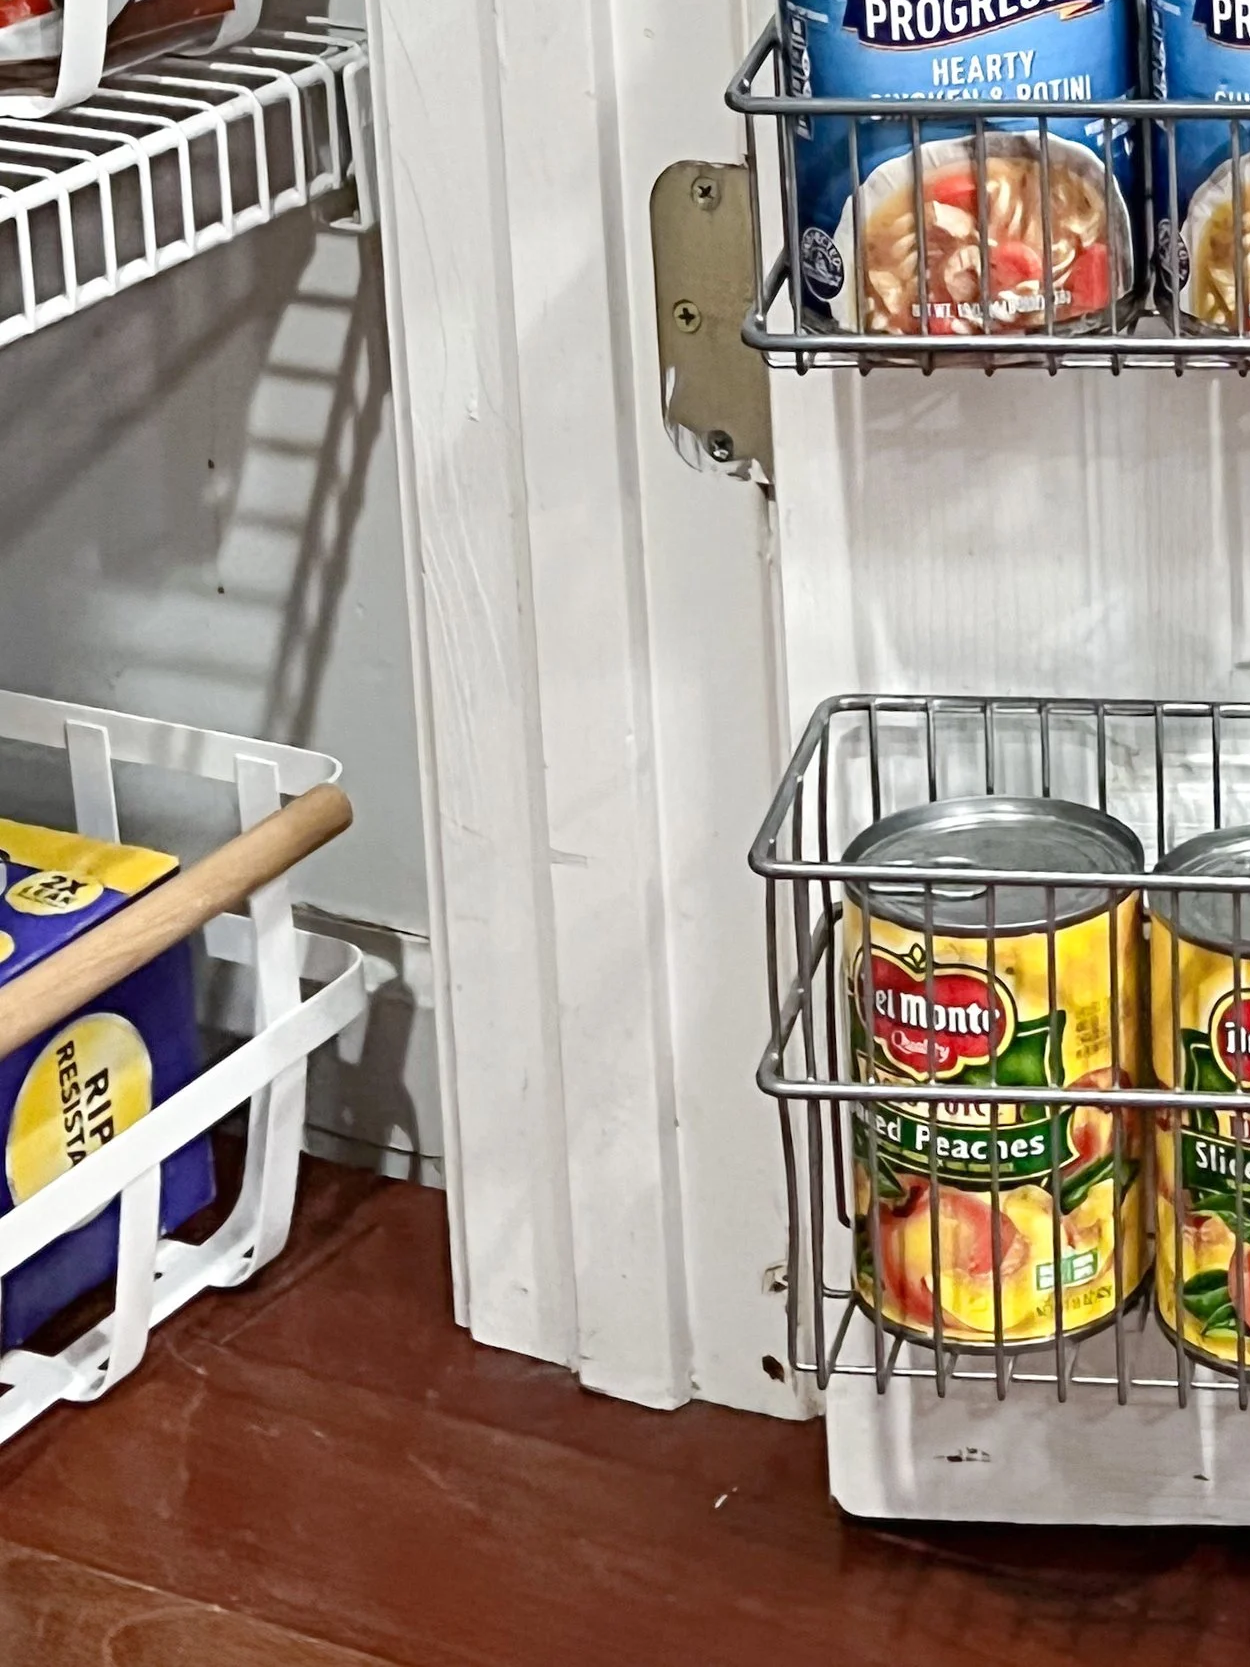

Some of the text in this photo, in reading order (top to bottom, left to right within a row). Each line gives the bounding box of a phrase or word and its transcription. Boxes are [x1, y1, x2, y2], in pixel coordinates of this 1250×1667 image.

[932, 50, 1035, 87] HEARTY
[56, 1040, 87, 1167] RESISTA
[85, 1067, 116, 1145] RIP
